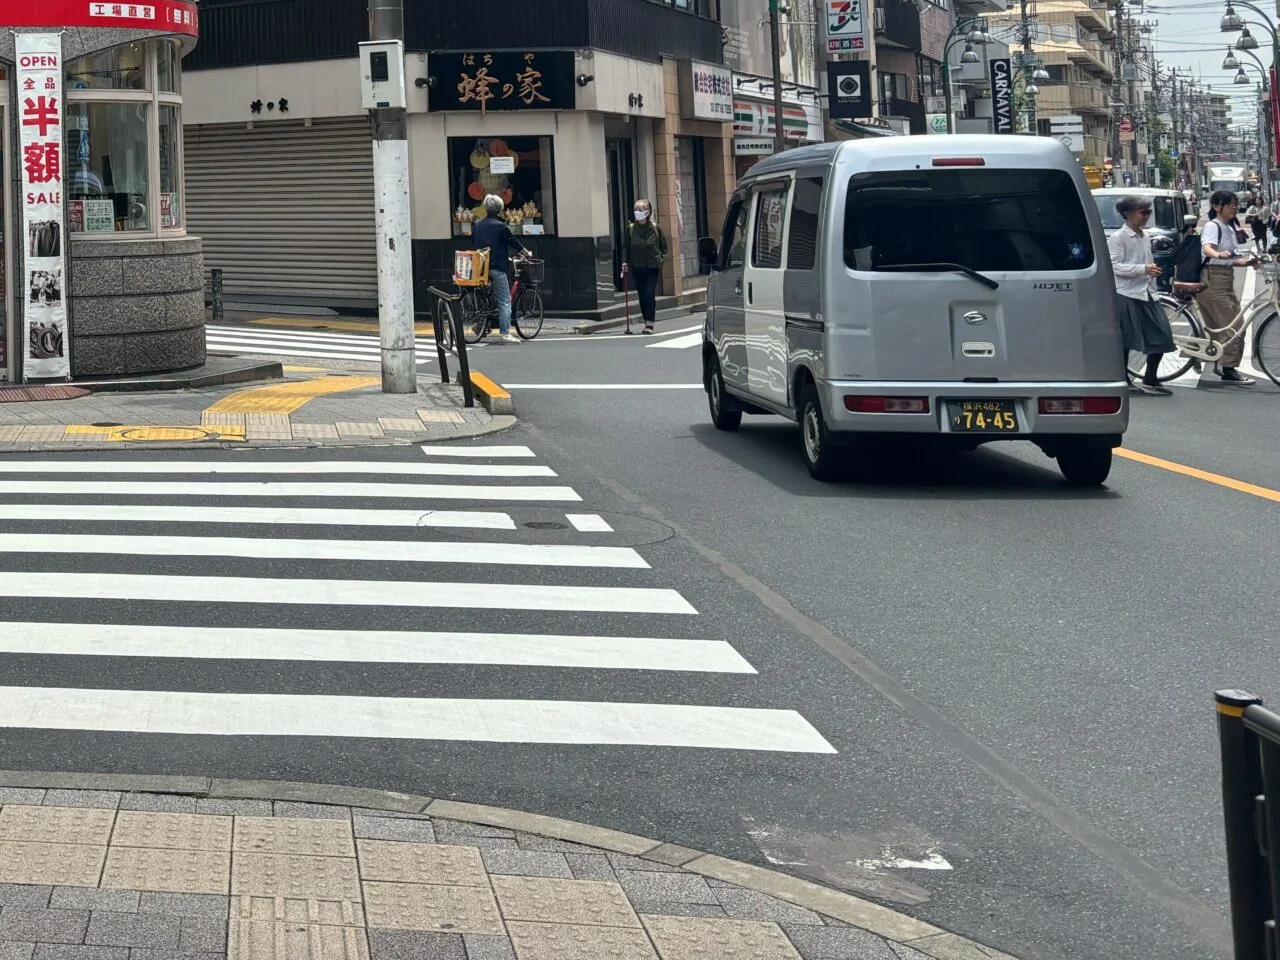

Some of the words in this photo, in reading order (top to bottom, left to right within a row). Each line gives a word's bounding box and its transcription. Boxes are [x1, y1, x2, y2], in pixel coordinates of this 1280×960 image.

[95, 4, 152, 18] 工場直営
[20, 55, 58, 68] OPEN
[462, 52, 493, 66] はち
[523, 52, 535, 65] や
[23, 76, 56, 90] 全品
[456, 67, 551, 118] 蜂の家
[250, 96, 290, 114] 蜂の家
[22, 95, 61, 184] 半額
[27, 191, 60, 205] SALE
[1033, 282, 1073, 290] HIJET
[983, 402, 1001, 411] 482
[962, 411, 1015, 429] 74-45
